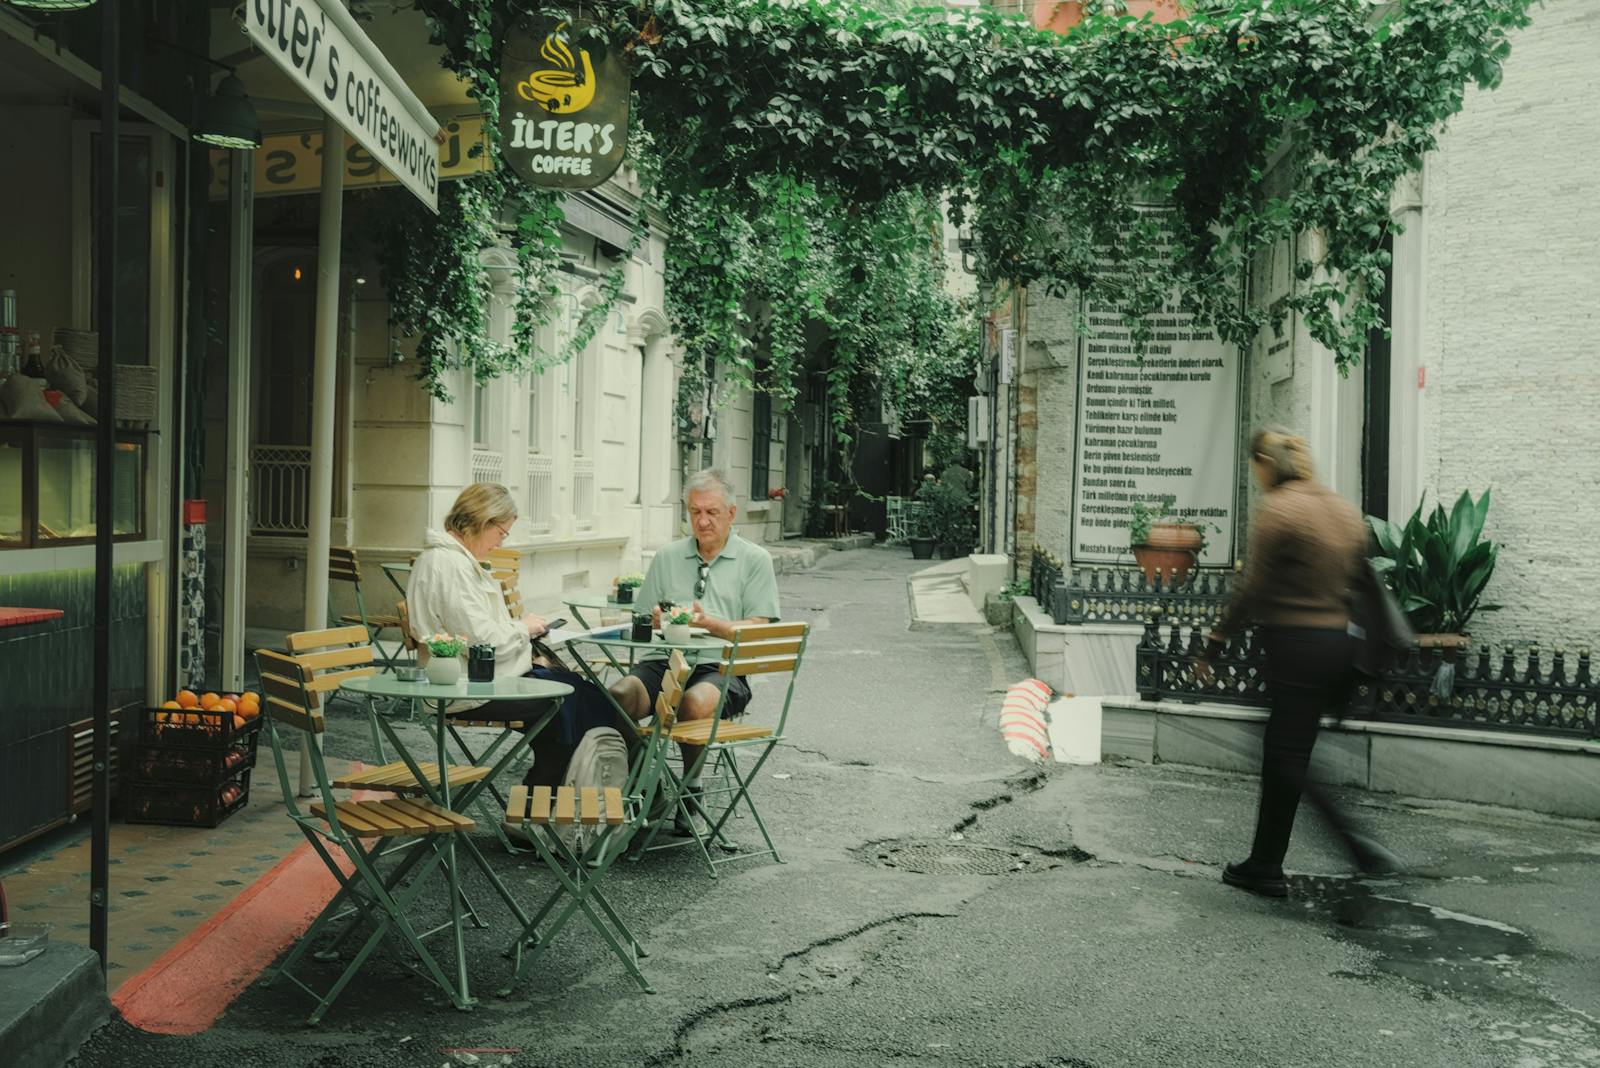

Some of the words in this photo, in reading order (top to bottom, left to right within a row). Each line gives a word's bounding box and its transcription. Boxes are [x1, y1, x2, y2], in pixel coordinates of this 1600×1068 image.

[346, 71, 436, 194] coffeeworks
[510, 112, 615, 155] İLTER'S
[532, 154, 592, 176] COFFEE
[1088, 343, 1107, 353] Daima
[1106, 371, 1139, 381] kahraman
[1137, 399, 1152, 408] Türk
[1140, 412, 1161, 422] elinde
[1085, 437, 1116, 447] Kahraman
[1084, 450, 1101, 460] Derin
[1083, 464, 1092, 473] Ve
[1093, 464, 1101, 474] bu
[1102, 464, 1123, 475] güveni
[1124, 465, 1145, 476] daima
[1083, 477, 1108, 487] Bundan
[1109, 478, 1126, 488] sonra
[1082, 490, 1096, 500] Türk
[1080, 517, 1094, 528] Hep
[1080, 543, 1107, 554] Mustafa
